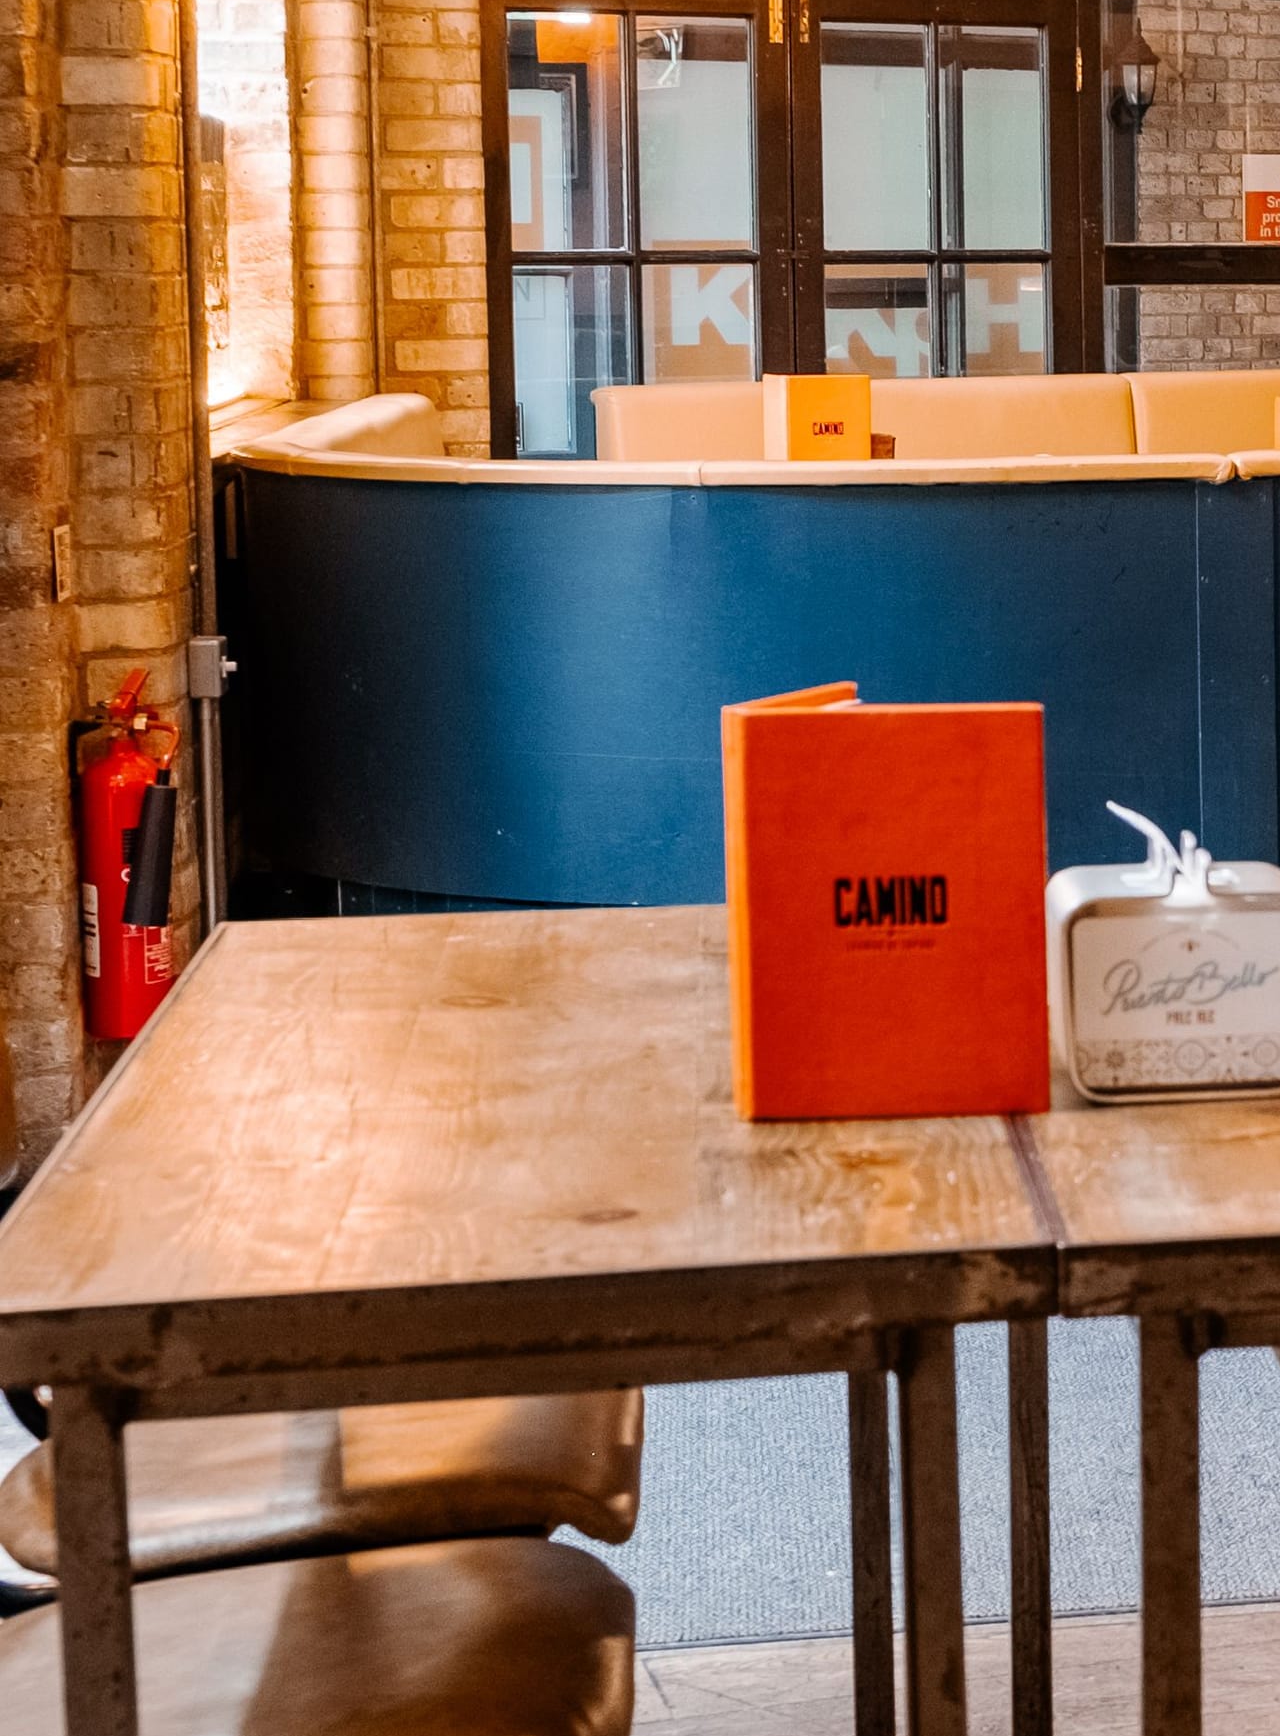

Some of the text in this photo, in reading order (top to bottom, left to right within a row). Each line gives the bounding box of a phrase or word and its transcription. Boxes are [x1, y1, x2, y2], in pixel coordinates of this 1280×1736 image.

[1260, 225, 1272, 238] in
[812, 422, 844, 435] CAMINO
[833, 874, 947, 927] CAMINO
[1102, 959, 1280, 1017] Puerto Bello
